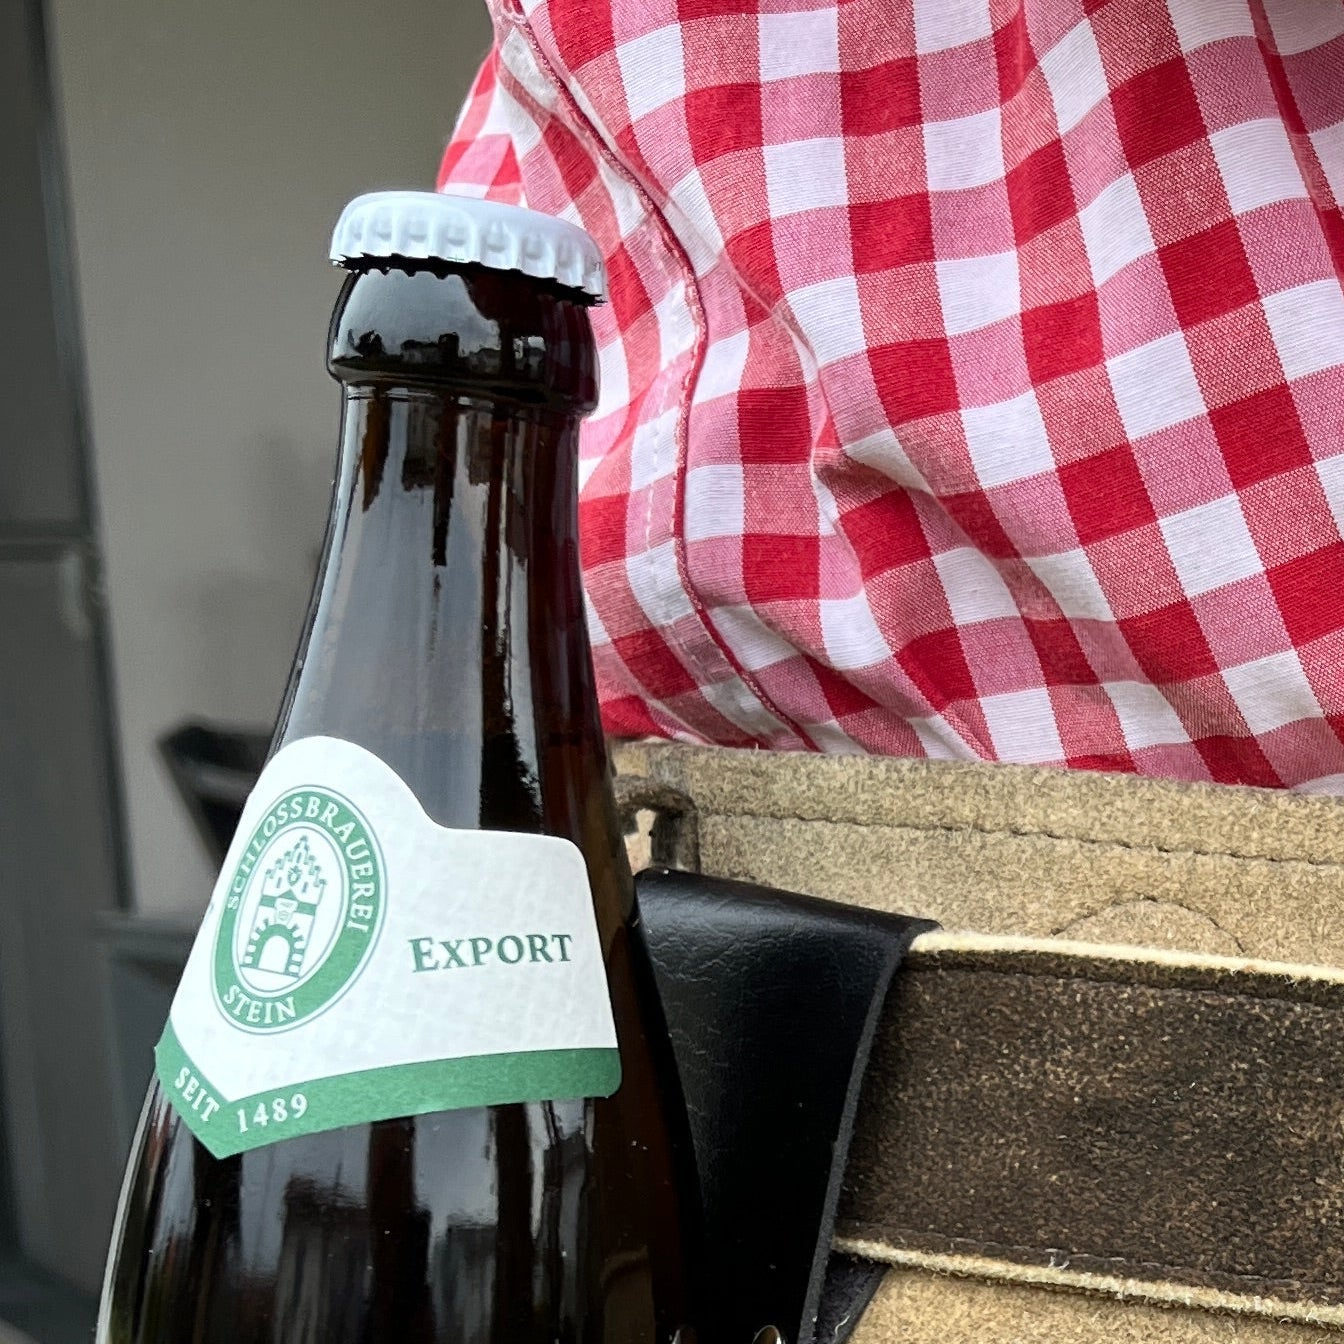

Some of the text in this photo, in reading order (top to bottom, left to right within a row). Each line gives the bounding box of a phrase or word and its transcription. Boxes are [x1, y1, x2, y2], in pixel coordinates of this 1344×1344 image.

[227, 795, 375, 934] SCHLOSSBRAUEREI
[408, 933, 573, 974] EXPORT
[223, 984, 297, 1025] STEIN
[174, 1065, 308, 1133] SEIT 1489
